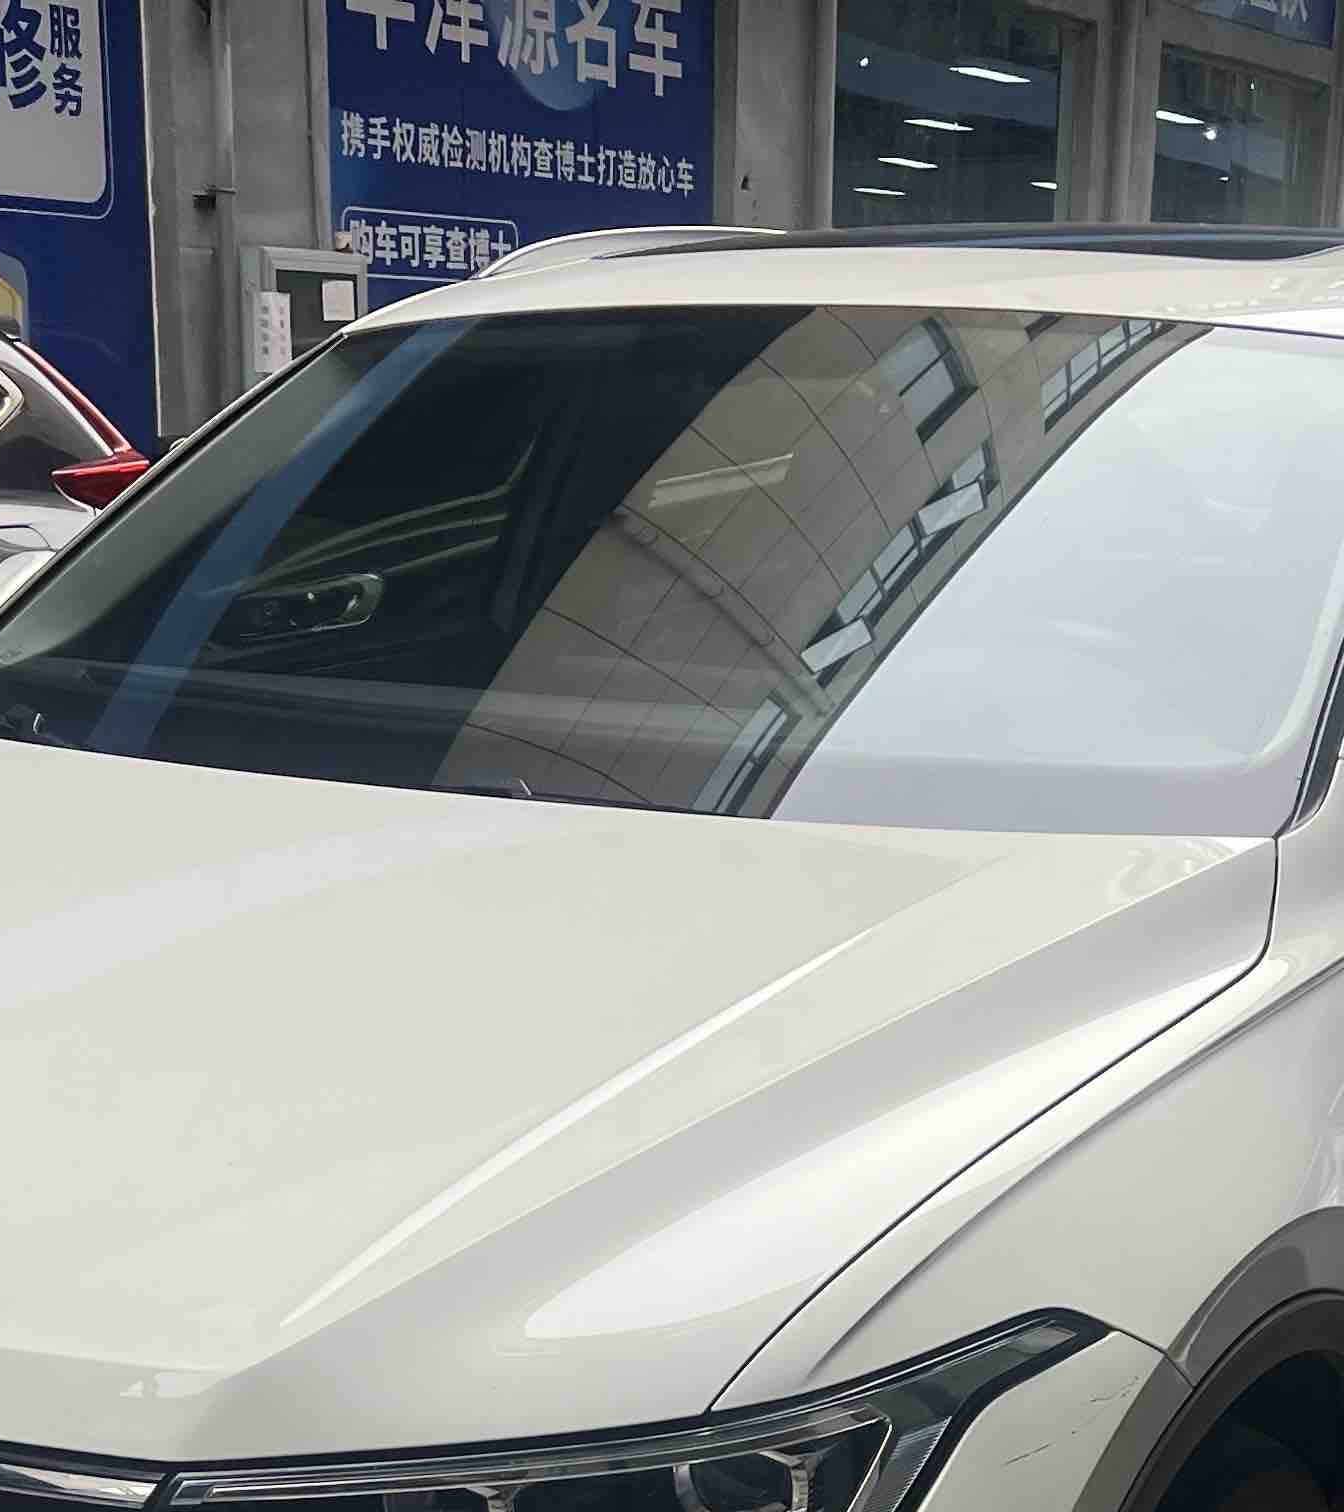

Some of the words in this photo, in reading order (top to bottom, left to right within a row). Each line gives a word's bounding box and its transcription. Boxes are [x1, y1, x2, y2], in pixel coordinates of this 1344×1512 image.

[340, 110, 695, 198] 携手权威检测机构查博士打造放心车
